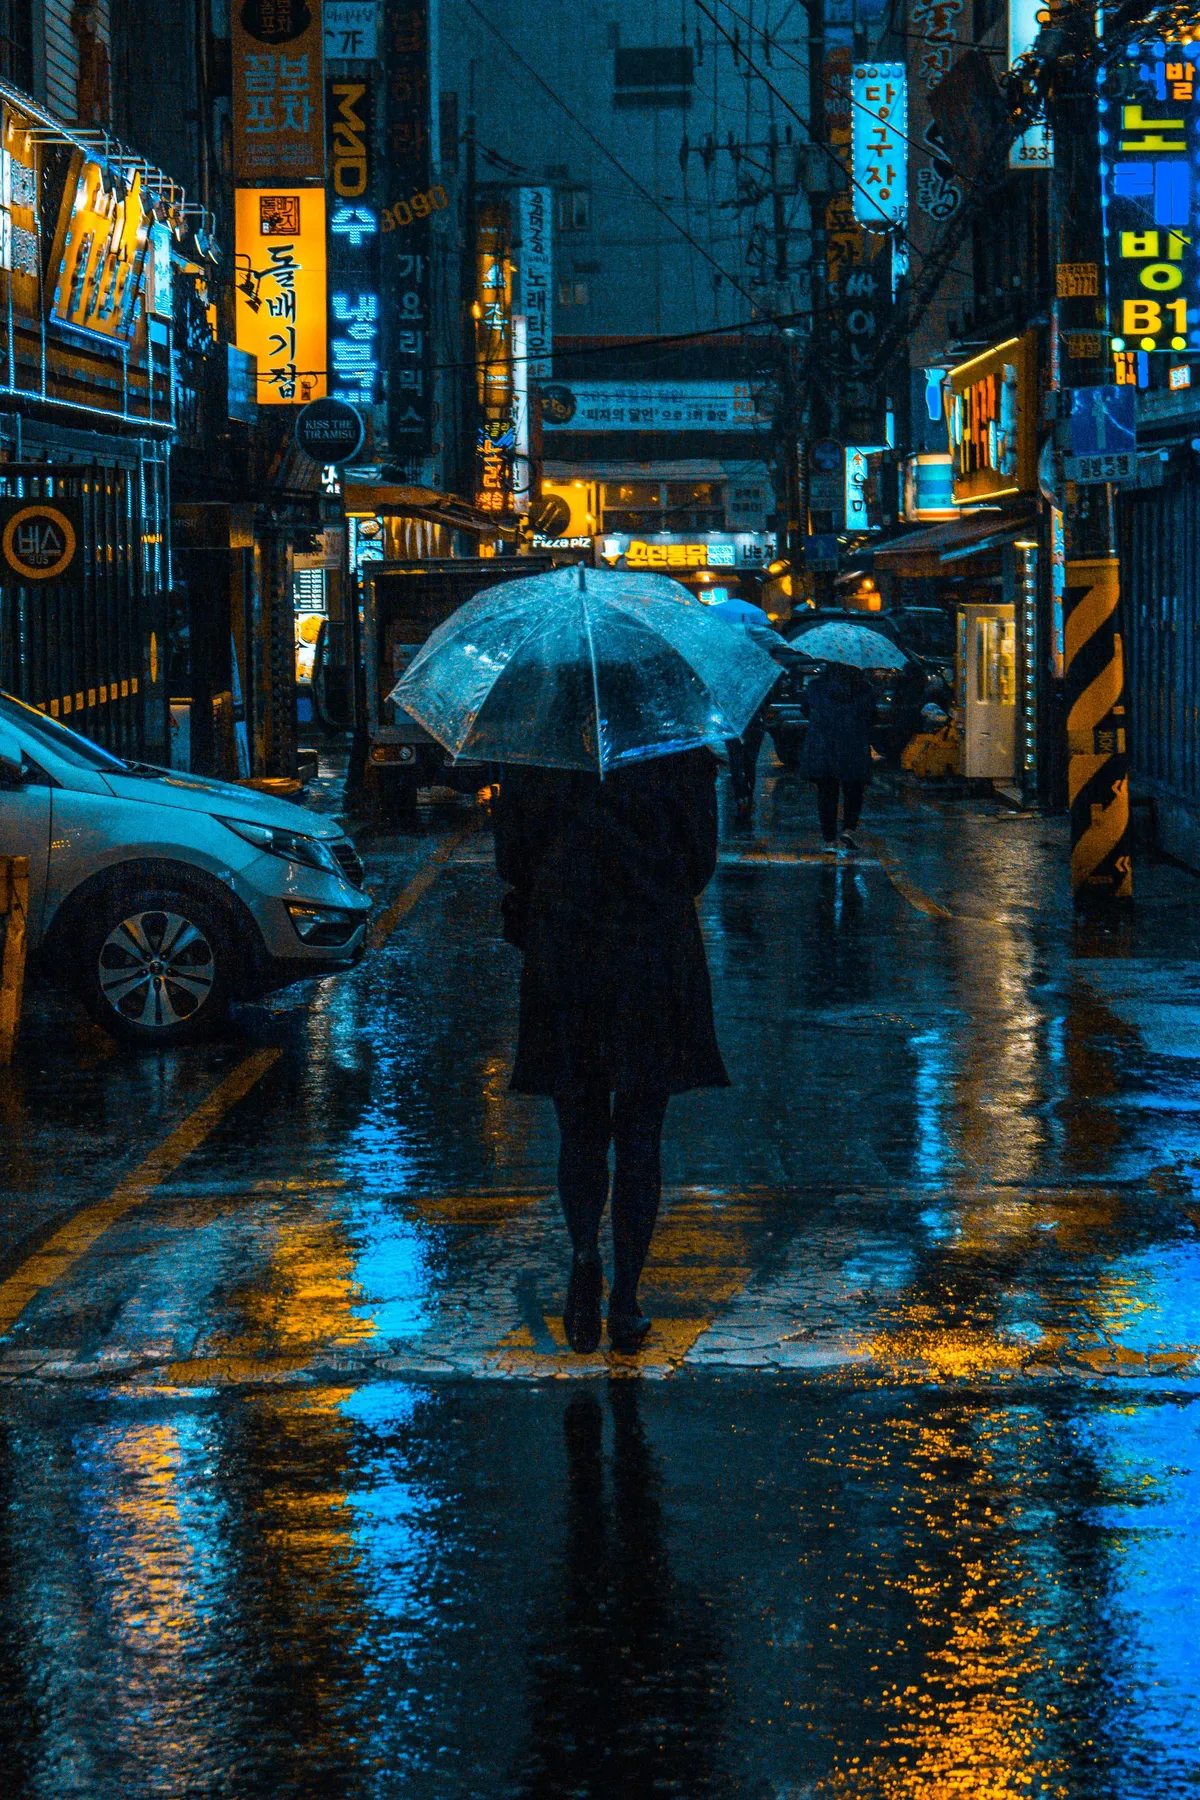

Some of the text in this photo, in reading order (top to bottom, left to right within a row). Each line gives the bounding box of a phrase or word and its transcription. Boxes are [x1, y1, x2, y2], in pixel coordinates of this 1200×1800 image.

[338, 30, 364, 54] 7F
[244, 95, 315, 133] 포차
[865, 82, 897, 201] 당구장
[1112, 104, 1191, 291] 노래방
[1123, 299, 1187, 335] B1
[304, 430, 357, 439] TIRAMISU
[305, 420, 354, 429] KISS THE
